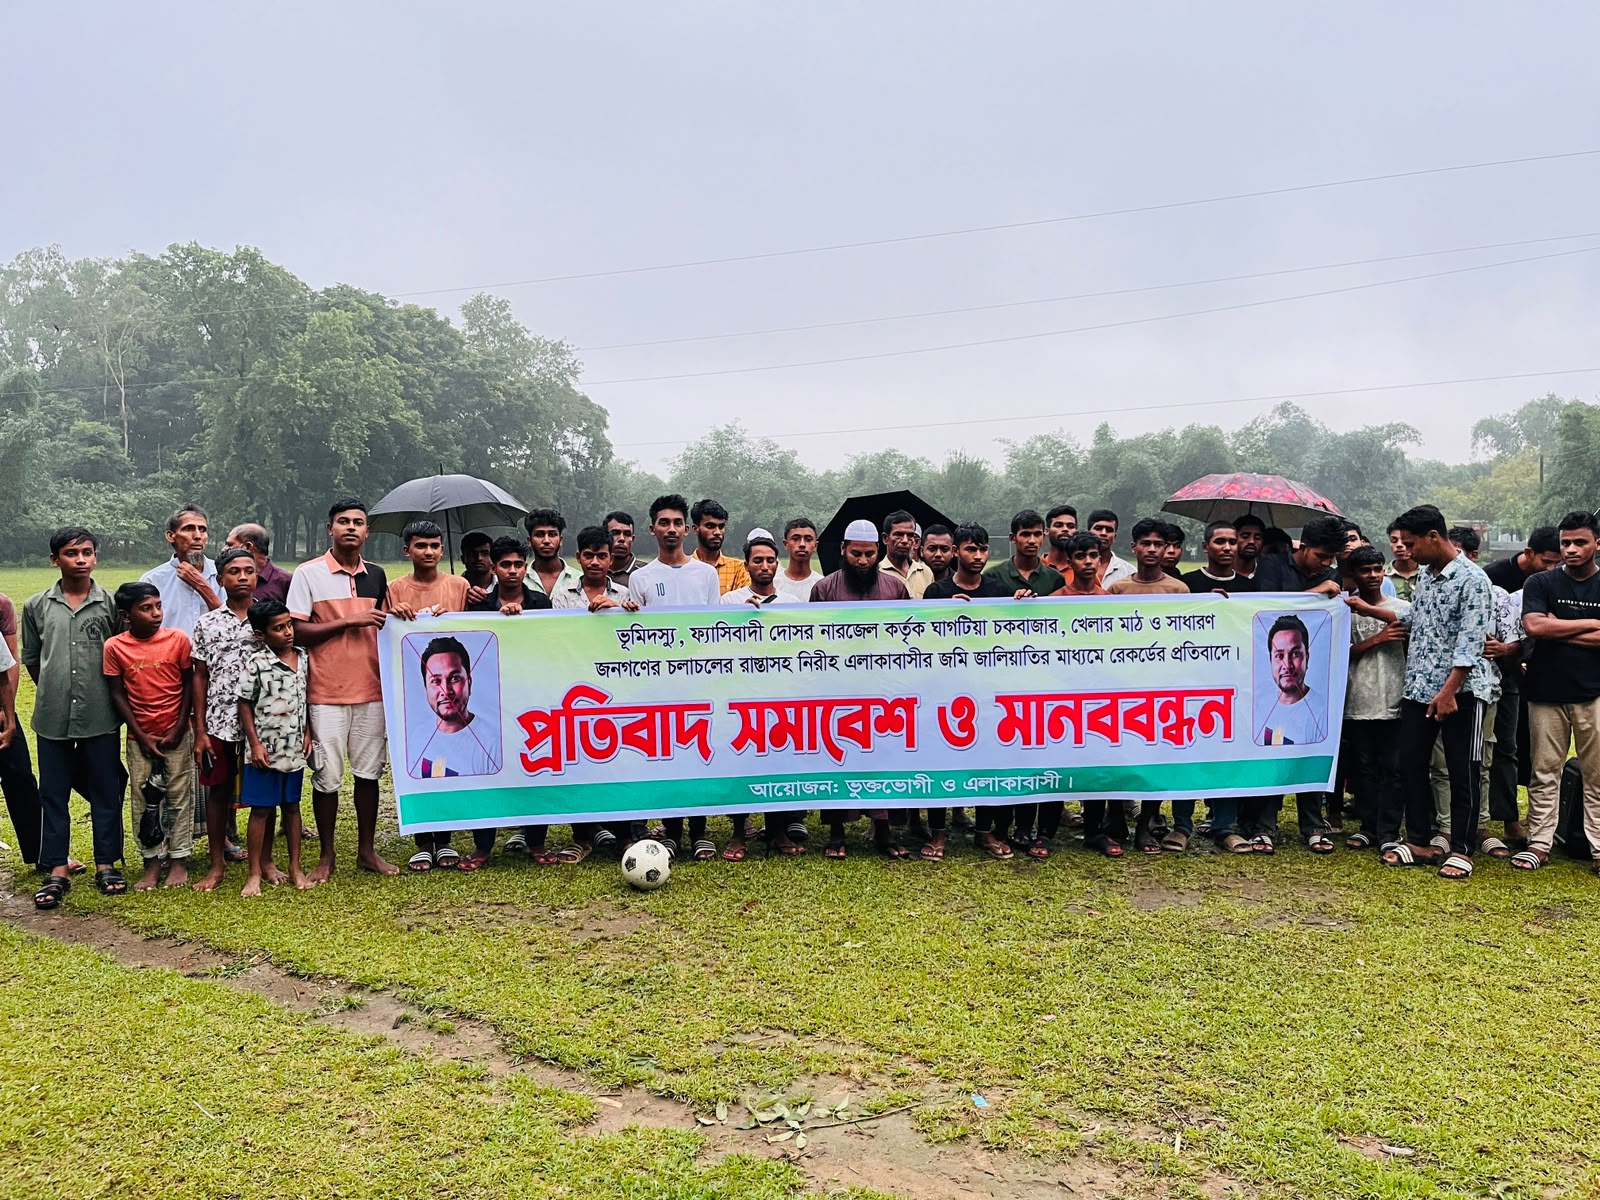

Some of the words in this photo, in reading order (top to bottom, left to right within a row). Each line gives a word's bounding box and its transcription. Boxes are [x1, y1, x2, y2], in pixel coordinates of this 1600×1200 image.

[655, 582, 666, 597] 10
[615, 622, 685, 651] ভূমিদস্যু,
[689, 619, 764, 644] ফ্যাসিবাদী
[769, 624, 814, 642] দোসর
[819, 622, 879, 641] নারজেল
[883, 615, 925, 645] কর্তৃক
[931, 615, 986, 637] ঘাগটিয়া
[993, 616, 1066, 637] চকবাজার,
[1071, 616, 1114, 635] খেলার
[1119, 610, 1143, 631] মাঠ
[1149, 615, 1162, 630] ও
[1166, 612, 1215, 631] সাধারণ
[594, 659, 661, 678] জনগণের
[667, 657, 733, 676] চলাচলের
[738, 655, 793, 674] রাস্তাসহ
[797, 649, 840, 673] নিরীহ
[844, 647, 933, 671] এলাকাবাসীর
[939, 648, 968, 669] জমি
[974, 645, 1049, 667] জালিয়াতির
[1055, 647, 1103, 666] মাধ্যমে
[1109, 641, 1166, 663] রেকর্ডের
[516, 684, 714, 774] প্রতিবাদ
[728, 696, 919, 763] সমাবেশ
[937, 696, 977, 748] ও
[994, 688, 1235, 747] মানববন্ধন
[845, 774, 934, 799] ভুক্তভোগী
[941, 781, 956, 792] ও
